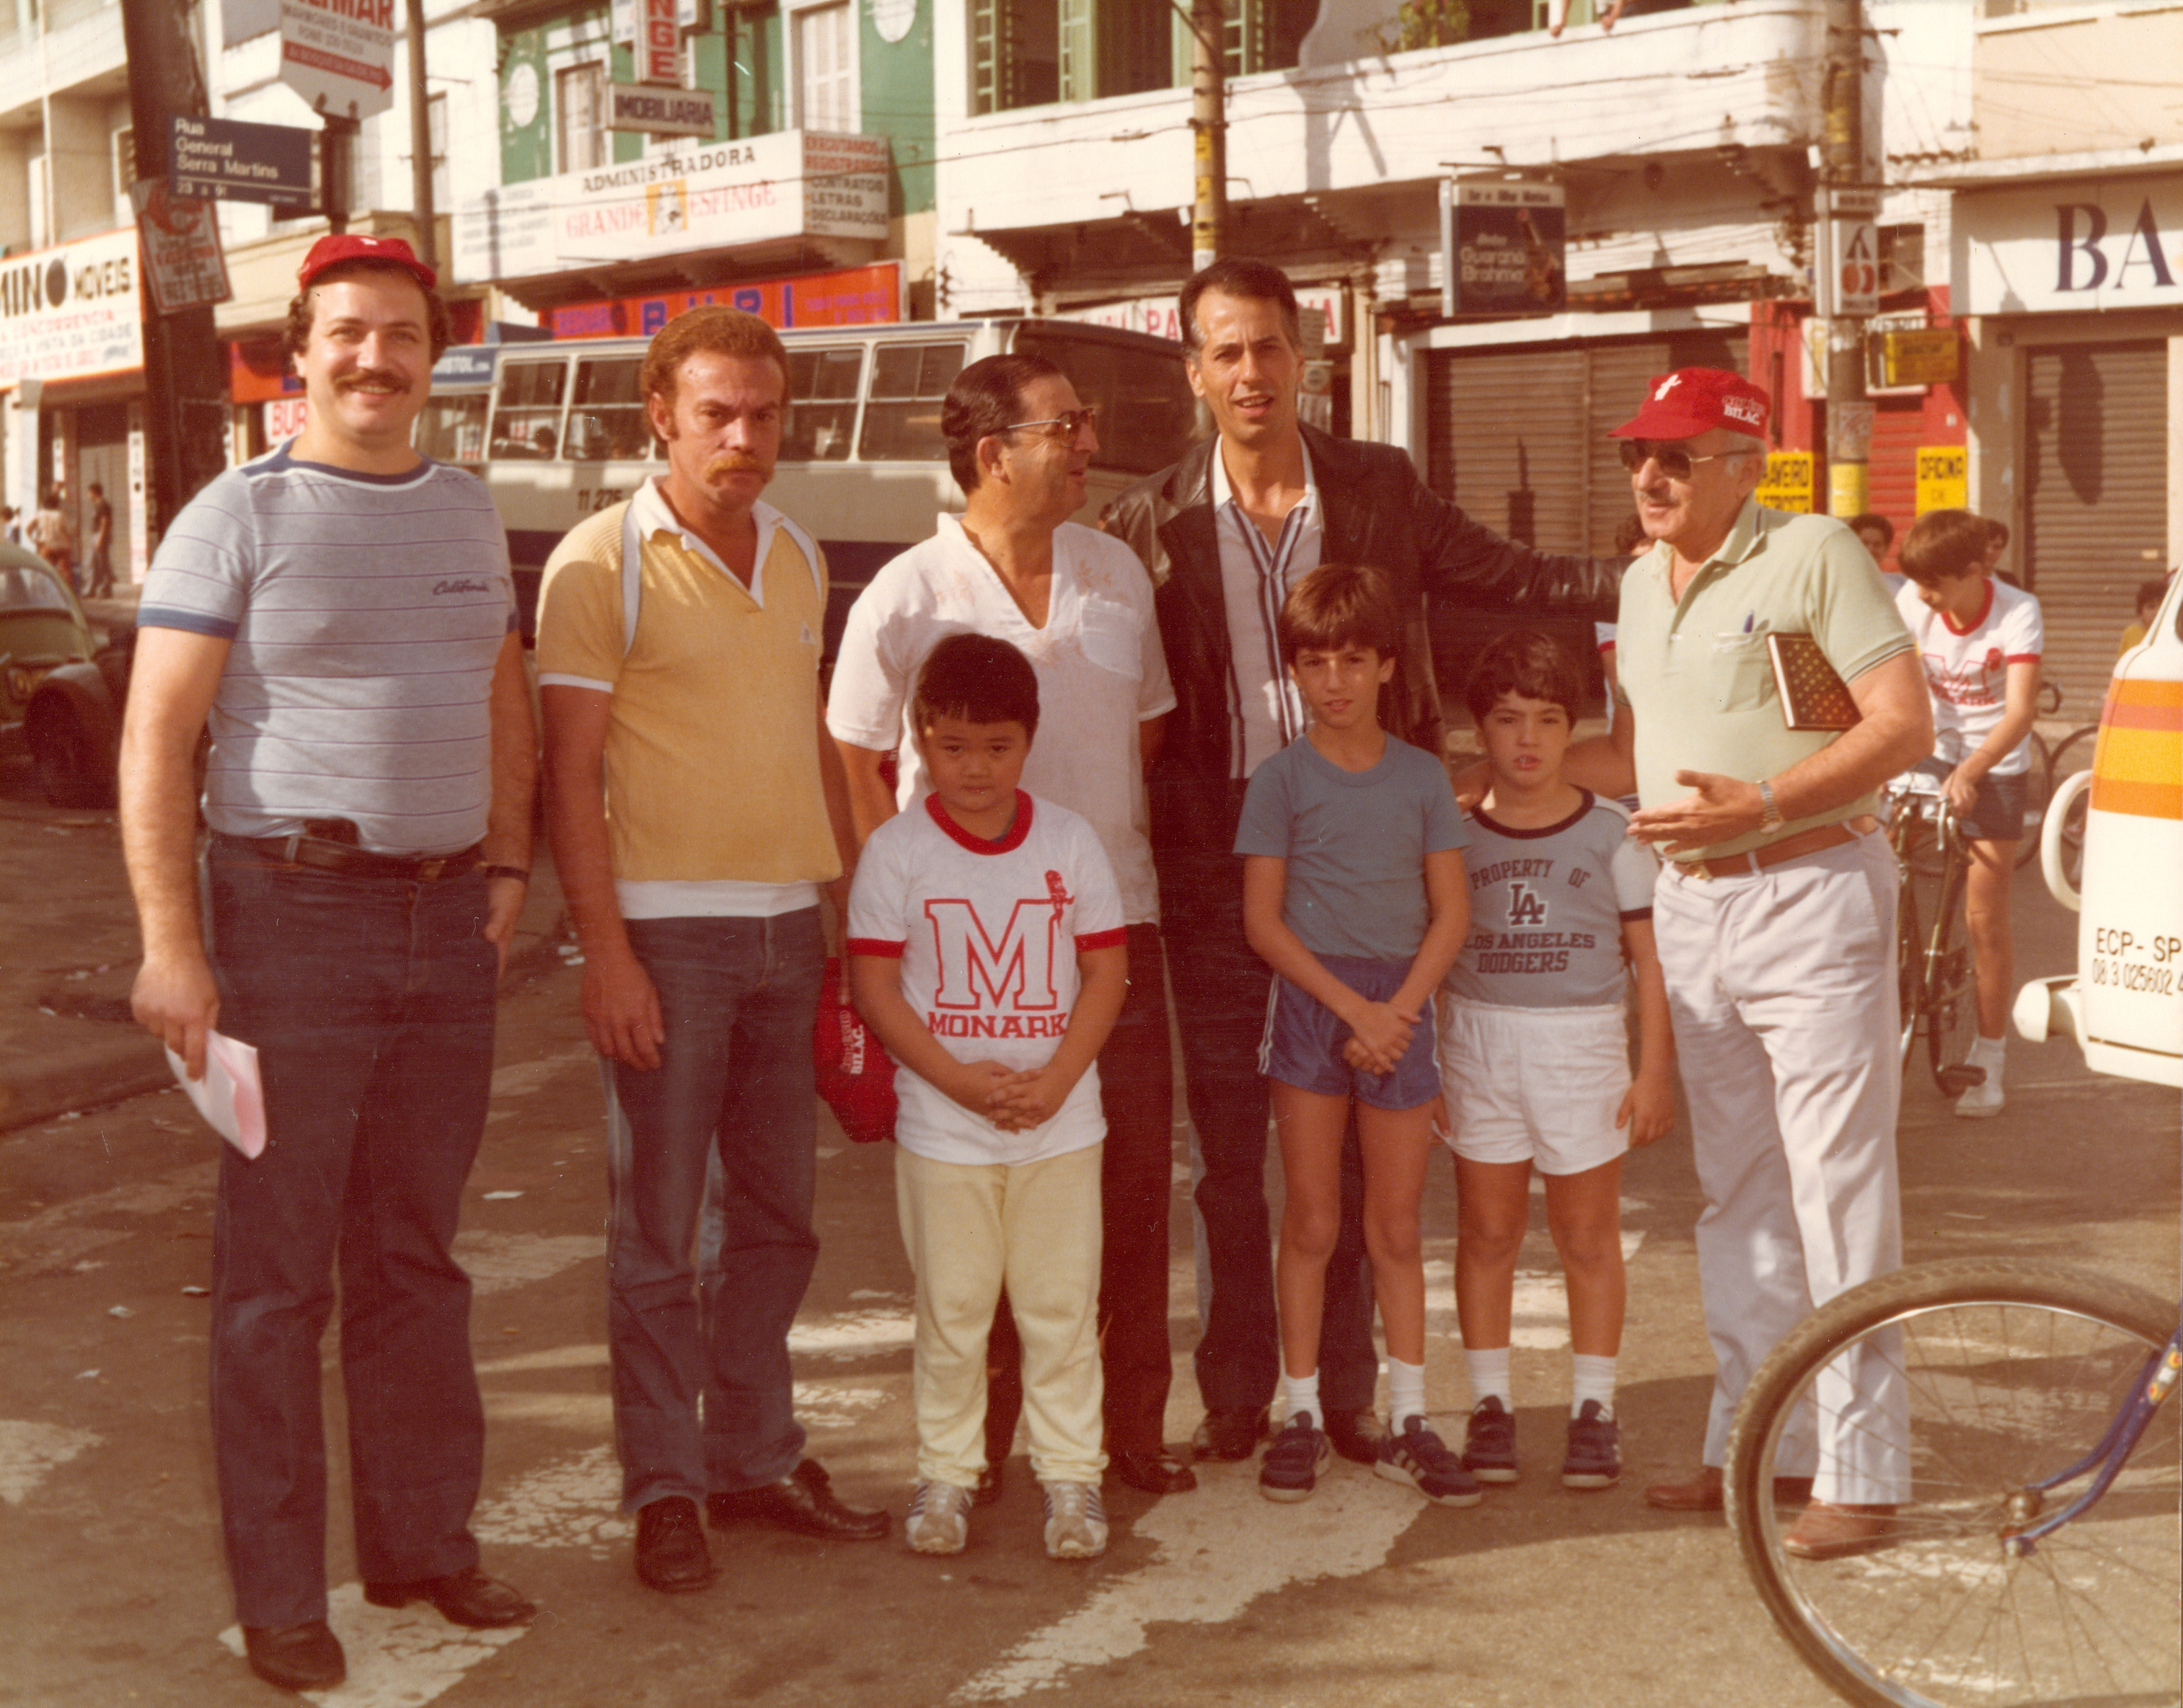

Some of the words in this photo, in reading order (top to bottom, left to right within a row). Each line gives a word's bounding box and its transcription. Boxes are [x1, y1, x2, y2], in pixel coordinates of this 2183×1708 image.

[175, 118, 204, 136] Rua
[175, 136, 232, 157] General
[177, 154, 216, 173] Serra
[582, 146, 755, 193] ADMINISTRADORA
[1470, 859, 1555, 890] PROPERTY
[1568, 867, 1592, 889] OF
[1506, 881, 1548, 928] LA
[924, 898, 1058, 1010] M
[1464, 934, 1495, 950] LOS
[1497, 932, 1597, 950] ANGELES
[1476, 950, 1570, 974] DODGERS
[927, 1011, 1067, 1039] MONARK
